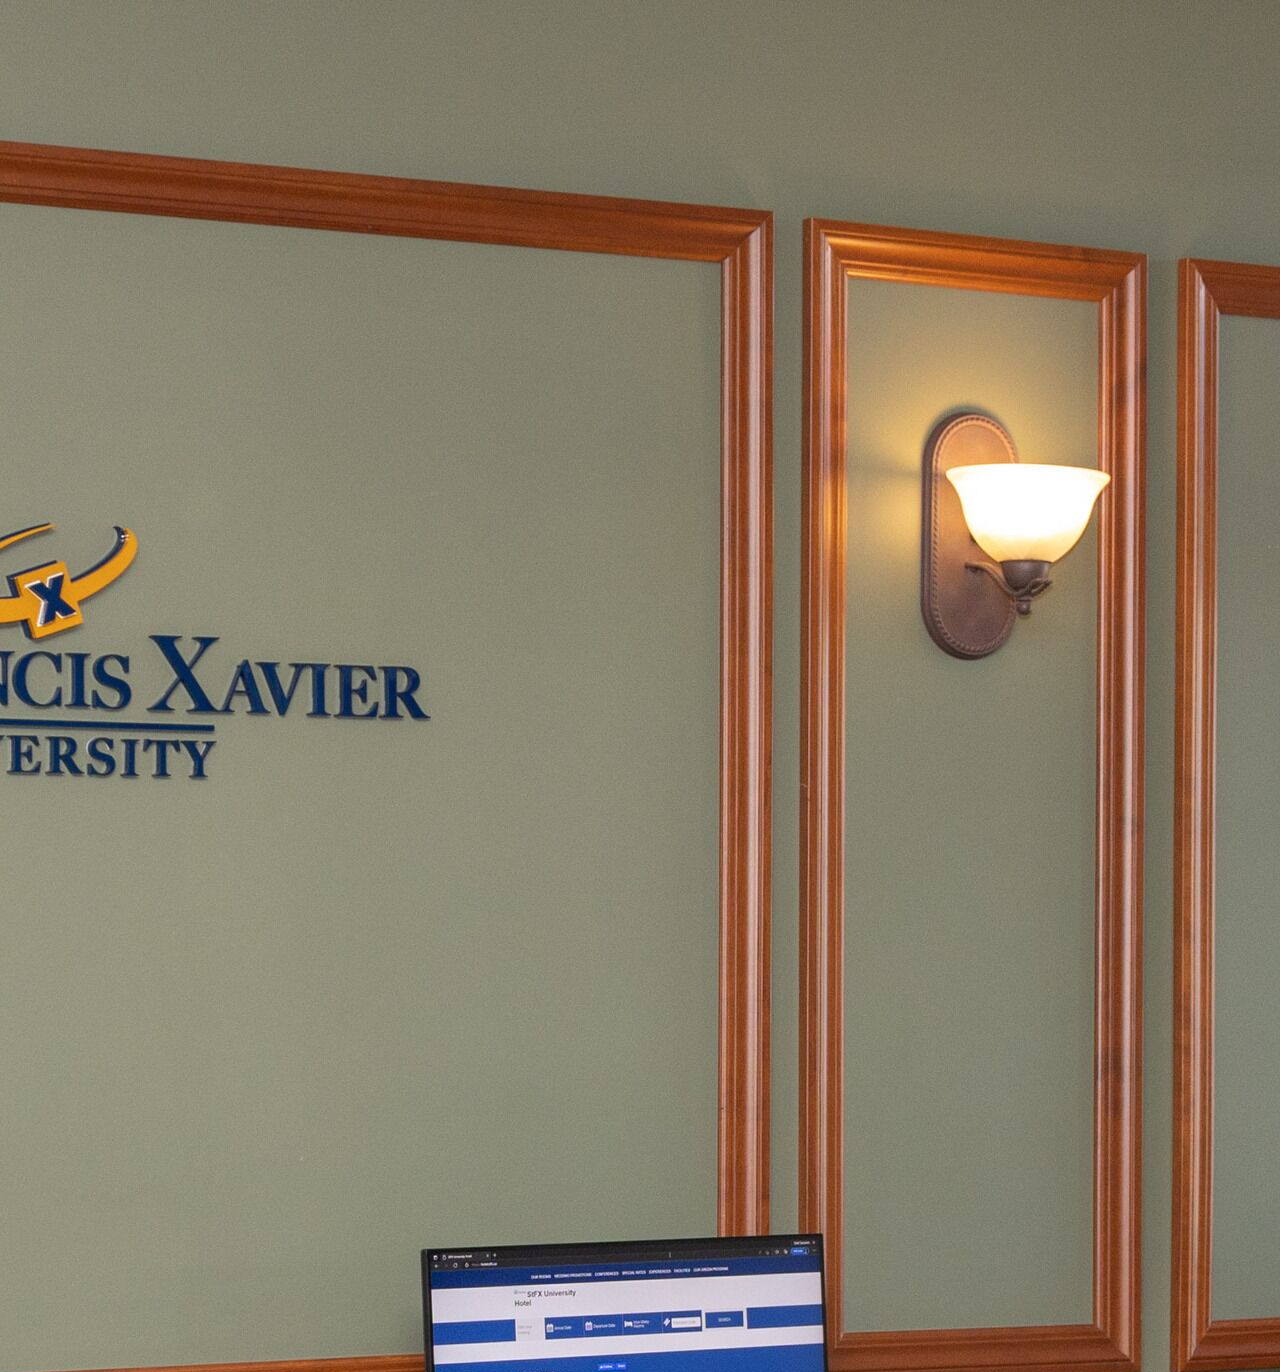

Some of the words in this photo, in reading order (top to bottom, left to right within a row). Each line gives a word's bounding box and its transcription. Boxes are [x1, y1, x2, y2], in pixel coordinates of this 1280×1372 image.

[147, 634, 431, 721] XAVIER
[544, 1289, 576, 1297] University
[514, 1299, 532, 1307] Hotel
